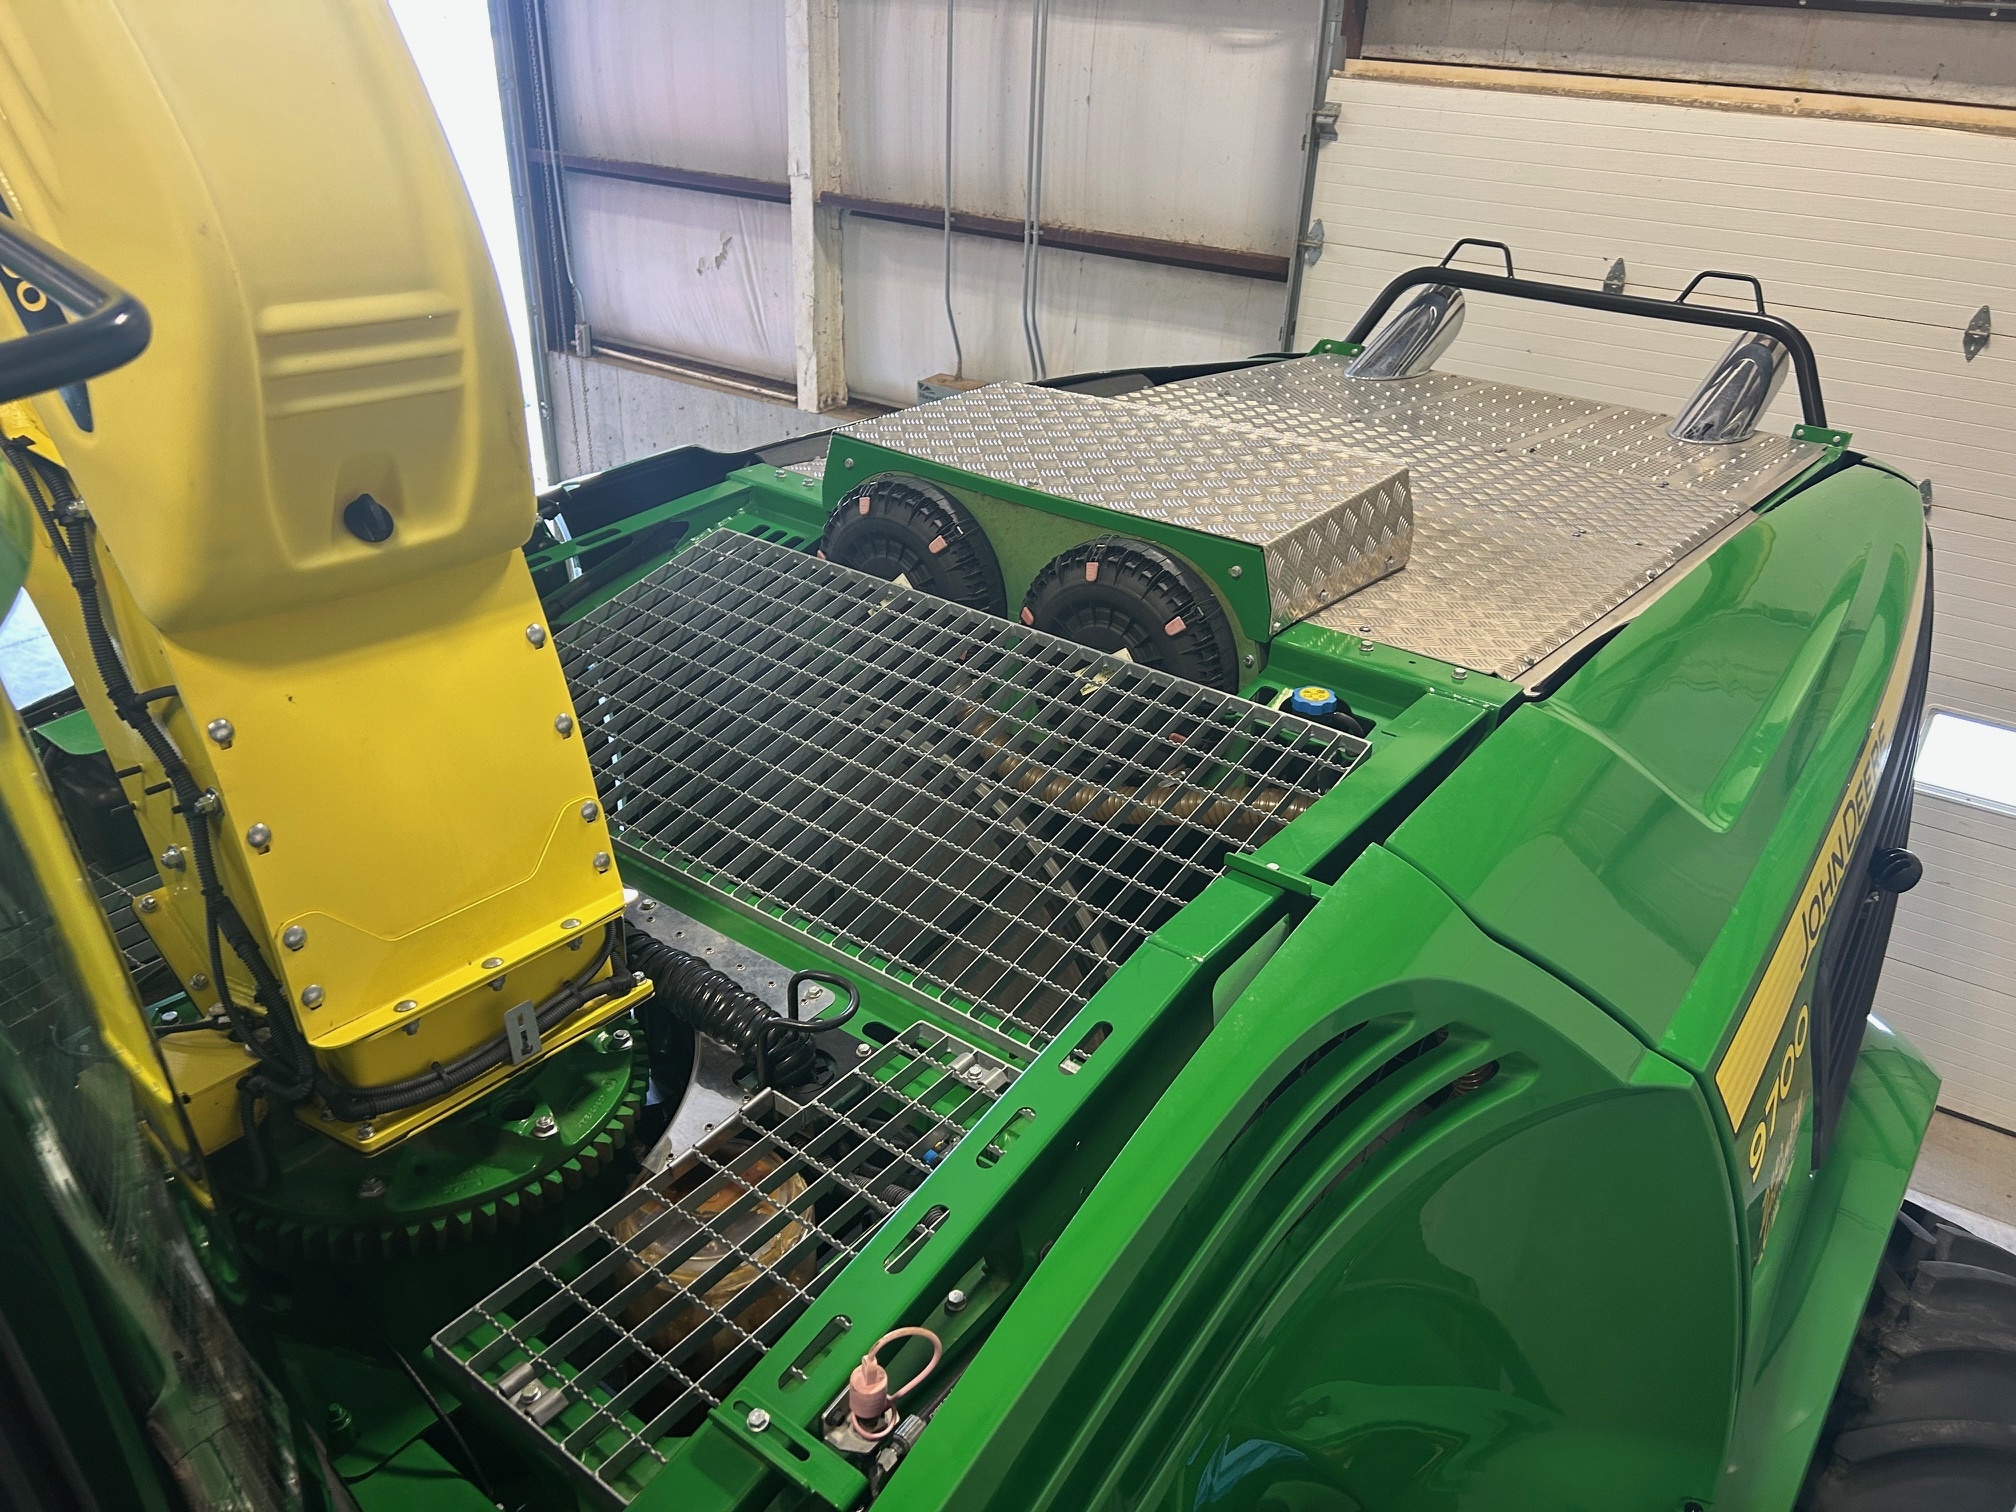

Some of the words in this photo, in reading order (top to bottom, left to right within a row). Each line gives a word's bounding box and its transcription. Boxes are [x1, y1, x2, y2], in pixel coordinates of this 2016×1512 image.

[1801, 834, 1845, 972] JOHN
[1842, 718, 1886, 854] DEERE
[1749, 1002, 1809, 1185] 9700
